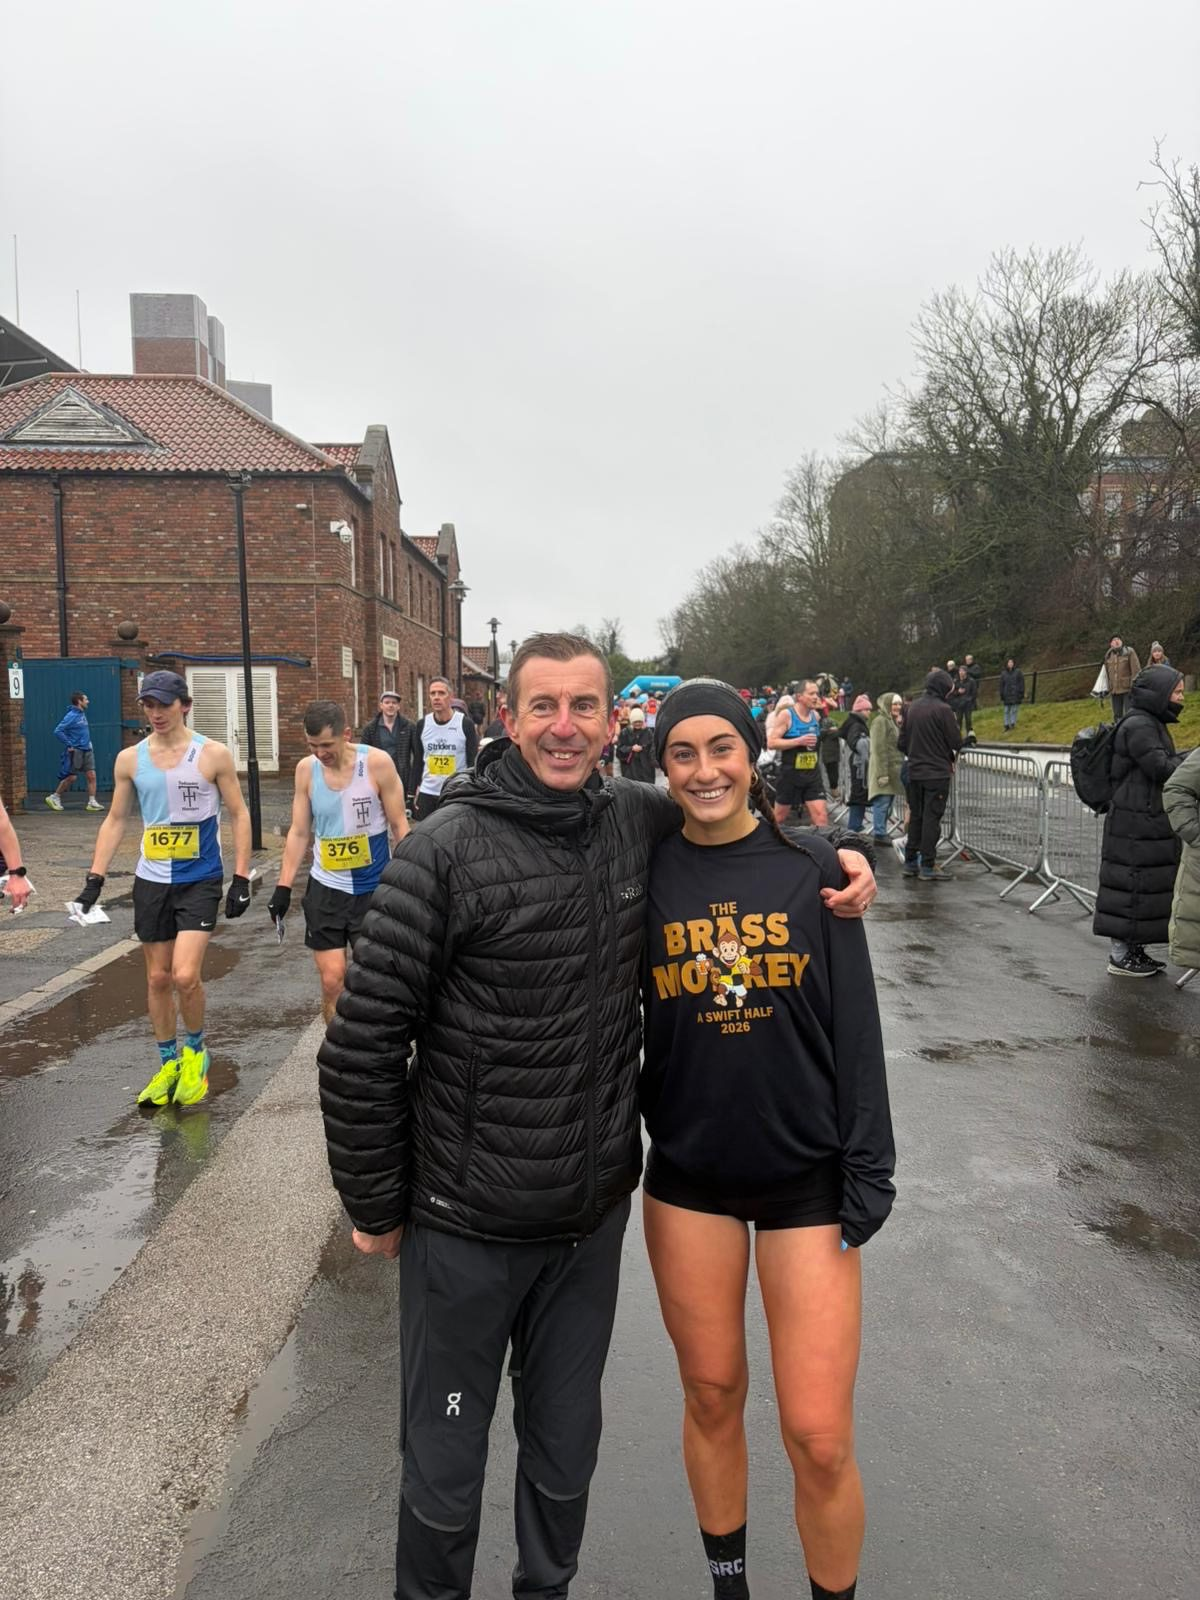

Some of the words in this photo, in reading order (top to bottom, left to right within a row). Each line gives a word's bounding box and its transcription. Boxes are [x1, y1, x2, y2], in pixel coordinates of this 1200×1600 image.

[13, 676, 20, 696] 9
[427, 743, 457, 751] Striders
[433, 757, 449, 766] 712
[150, 831, 193, 846] 1677
[328, 841, 360, 857] 376
[709, 902, 738, 916] THE
[664, 912, 790, 956] BRASS
[697, 1013, 703, 1023] A
[705, 1009, 741, 1022] SWIFT
[744, 1006, 773, 1019] HALF
[721, 1021, 751, 1034] 2026
